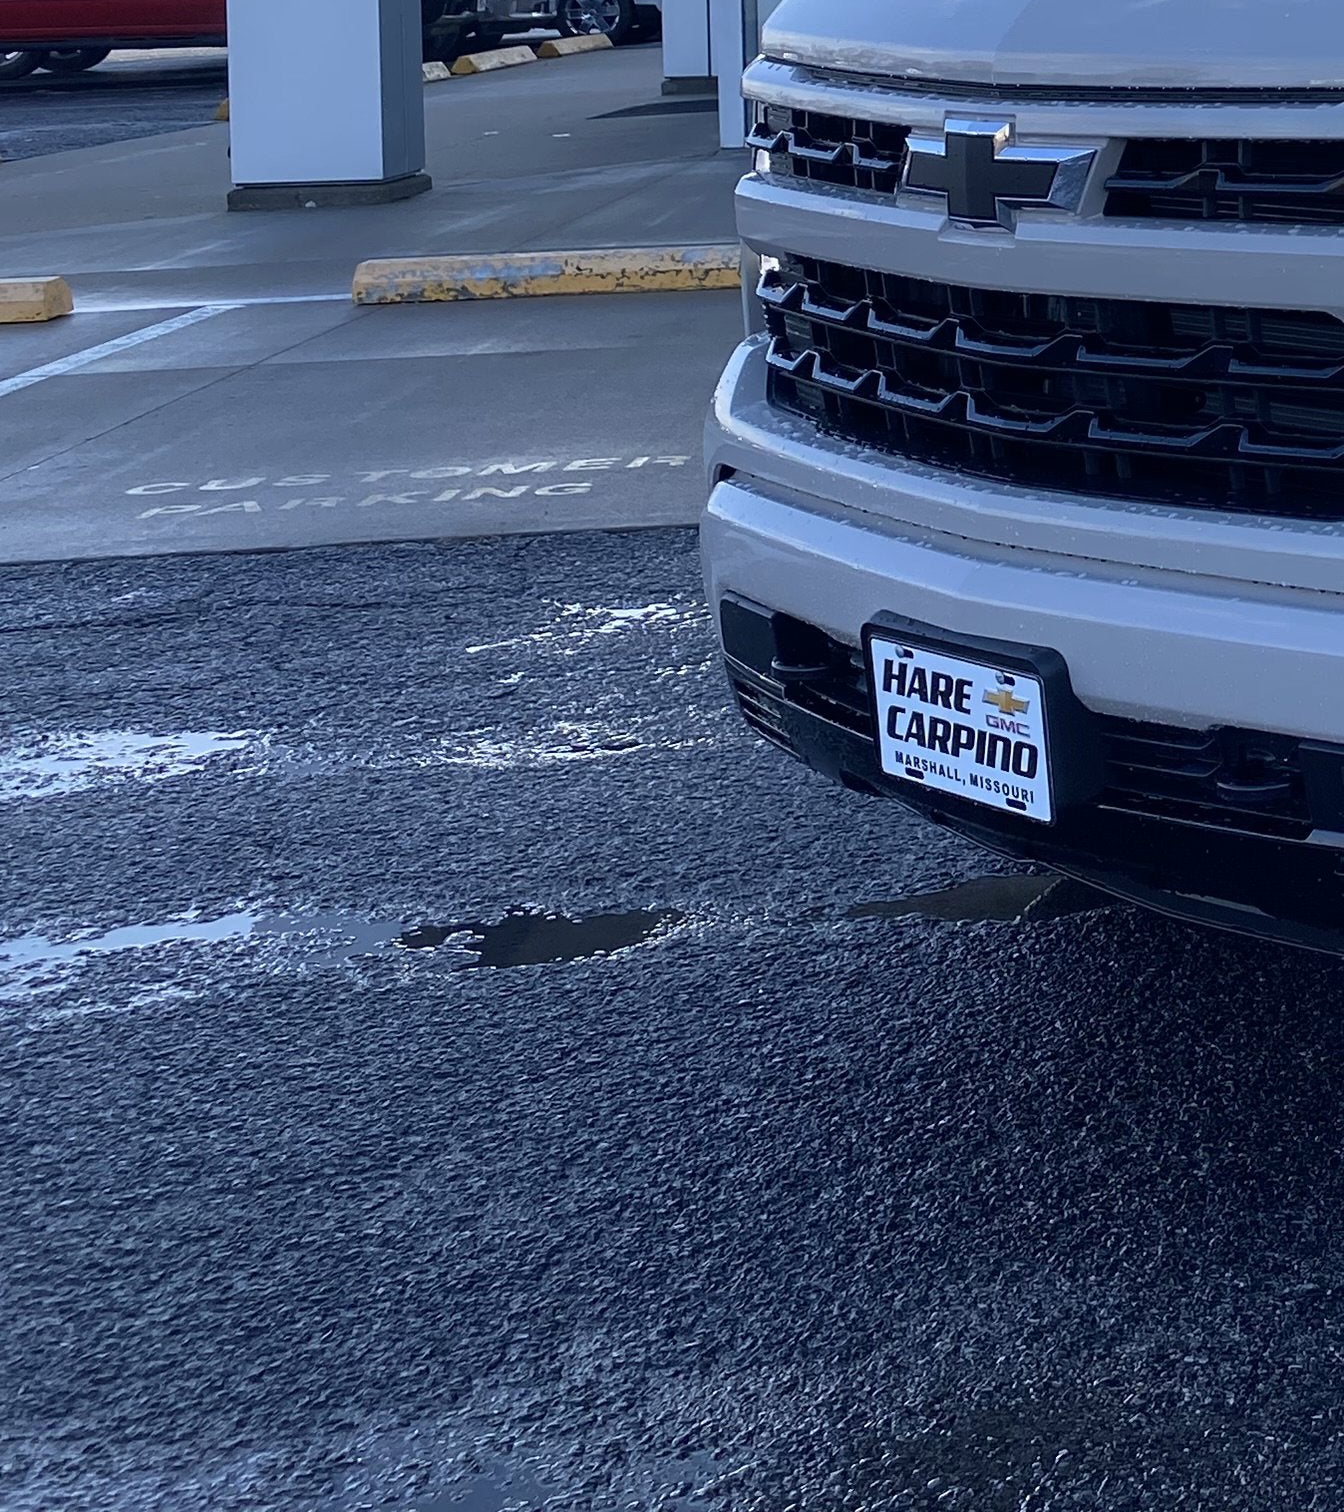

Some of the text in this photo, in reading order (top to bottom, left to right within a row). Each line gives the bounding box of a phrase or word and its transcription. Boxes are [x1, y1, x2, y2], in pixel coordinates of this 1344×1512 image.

[125, 455, 692, 496] CUSTOMER
[136, 482, 593, 520] PARKING
[882, 658, 974, 716] HARE
[886, 704, 1039, 780] CARPINO
[985, 714, 1031, 738] GMC
[895, 750, 1034, 805] MARSHALL, MISSOURI
